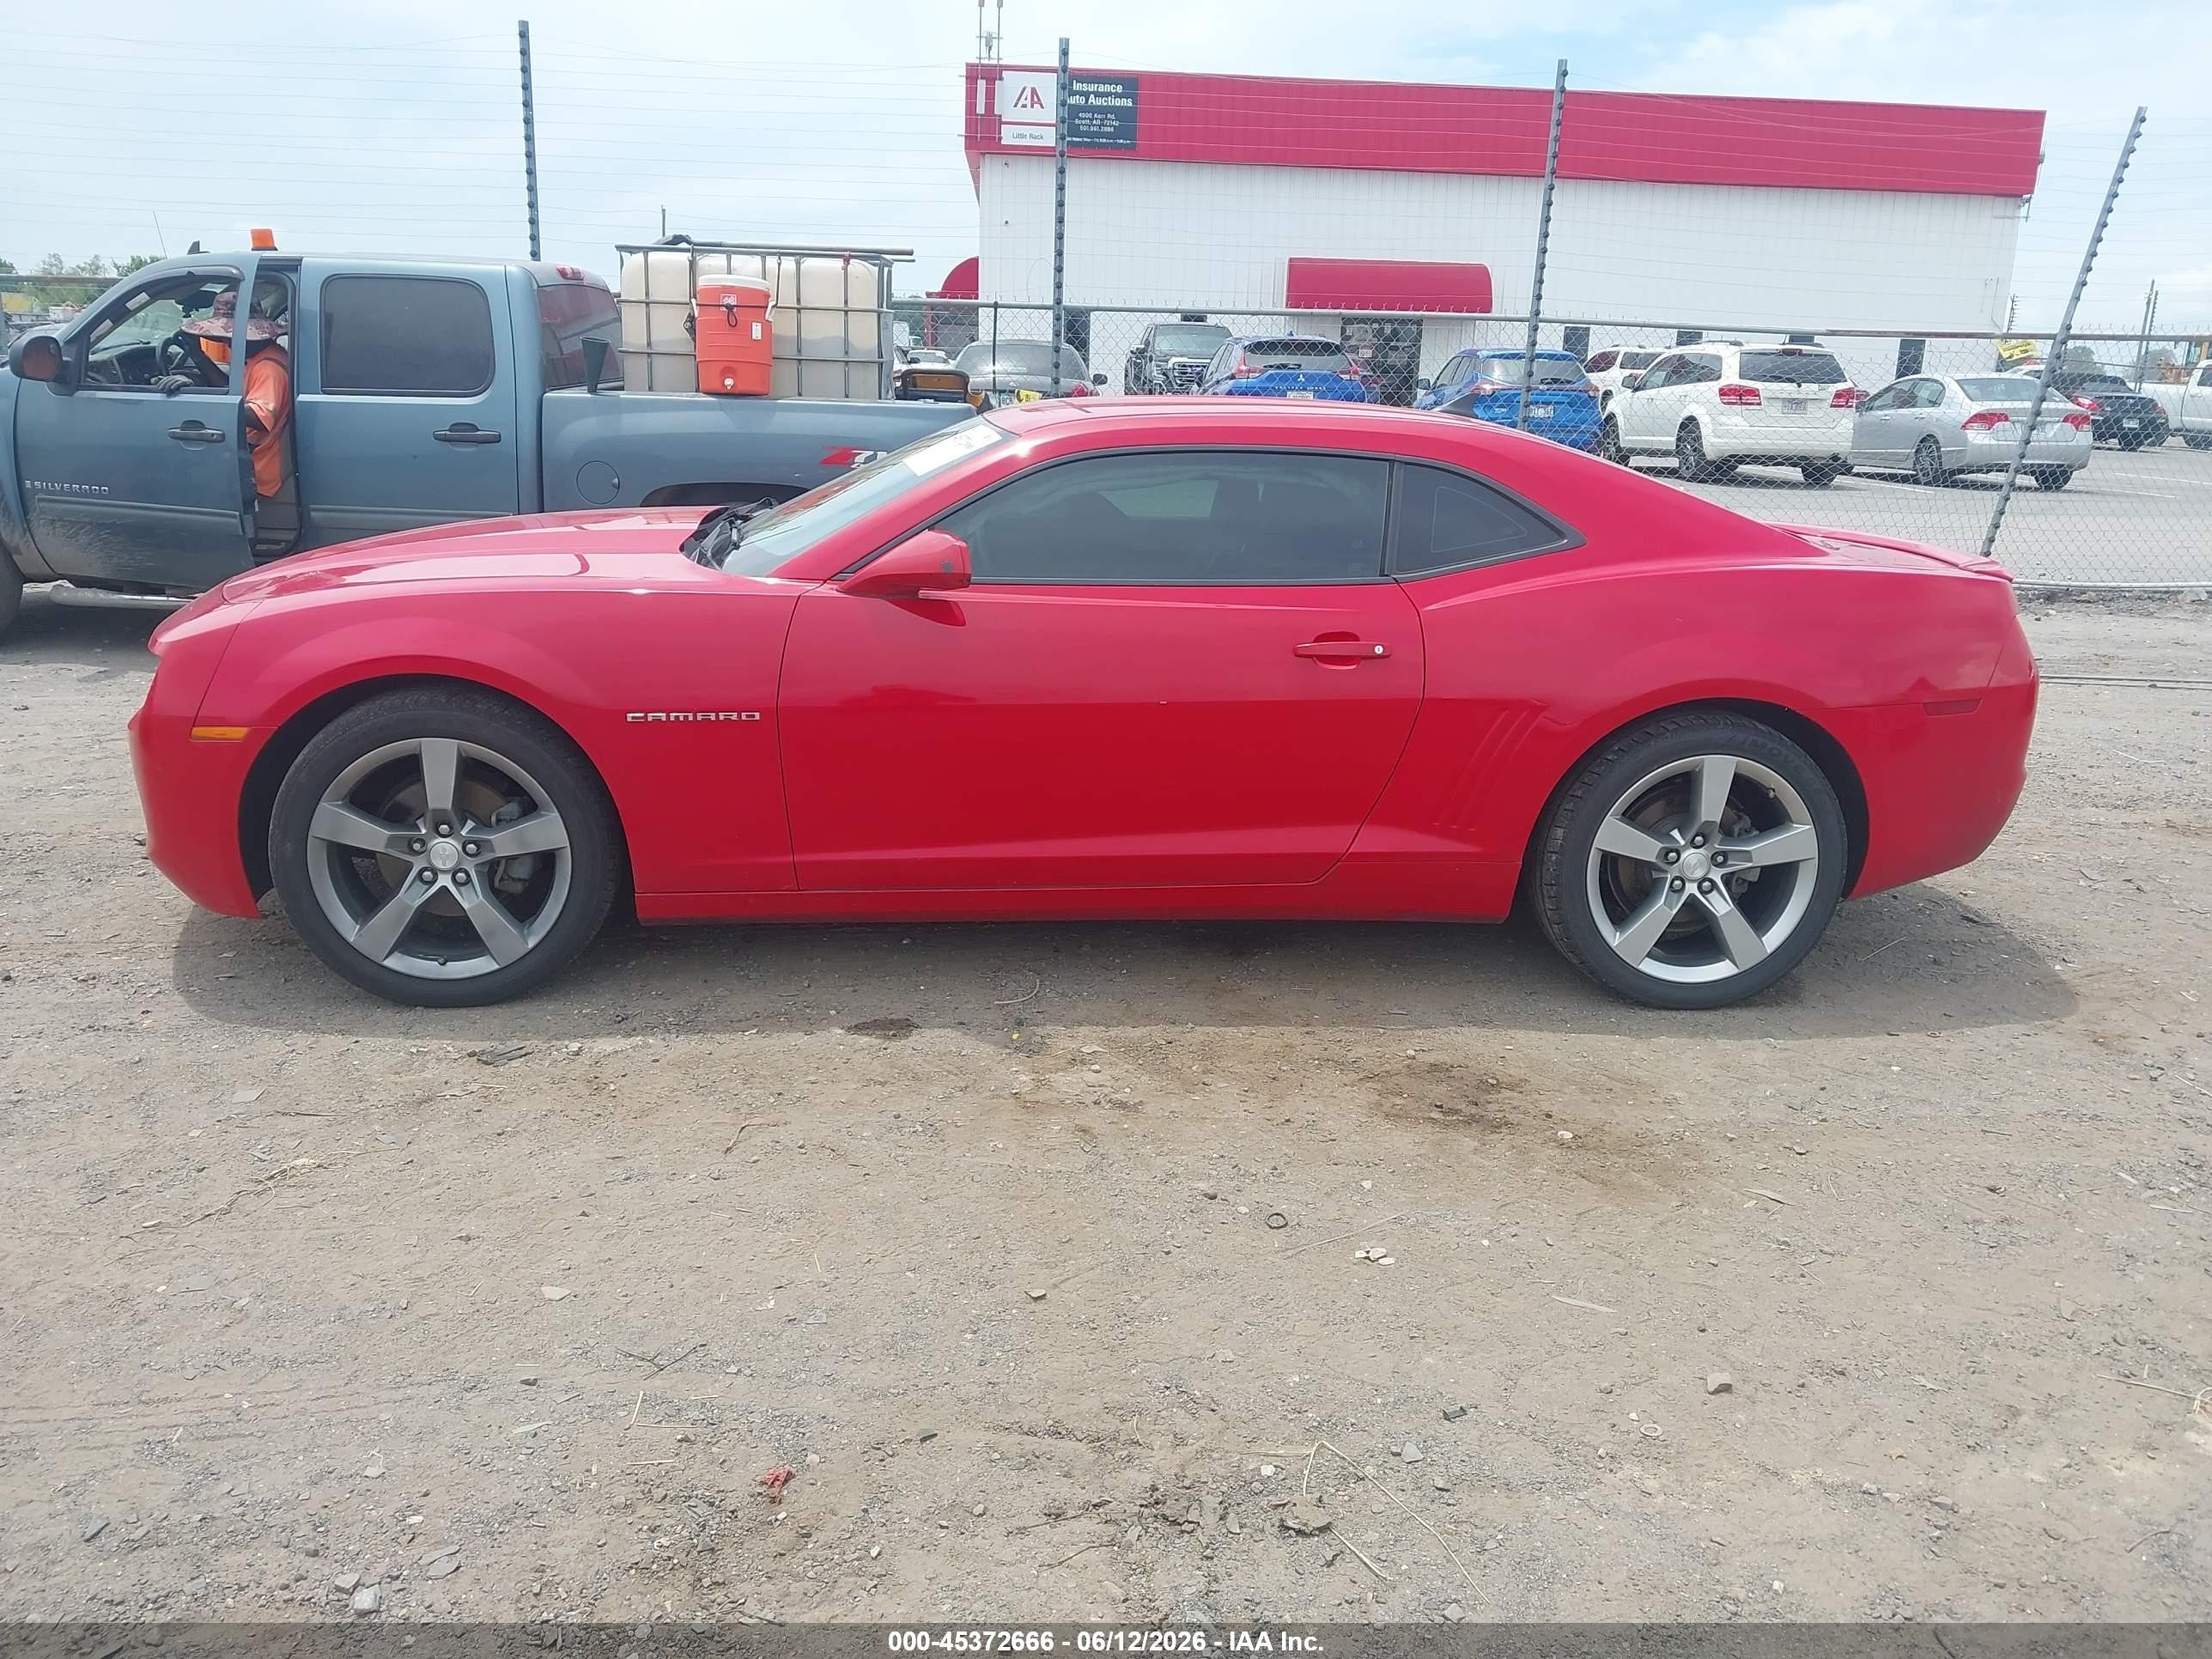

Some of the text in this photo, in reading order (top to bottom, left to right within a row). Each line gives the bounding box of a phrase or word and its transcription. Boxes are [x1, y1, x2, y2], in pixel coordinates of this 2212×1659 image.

[1073, 80, 1123, 93] Insurance
[1067, 94, 1133, 106] uto Auctions
[1012, 131, 1045, 141] Little Rock
[33, 481, 109, 495] SILVERADO
[626, 712, 761, 722] CAMARO
